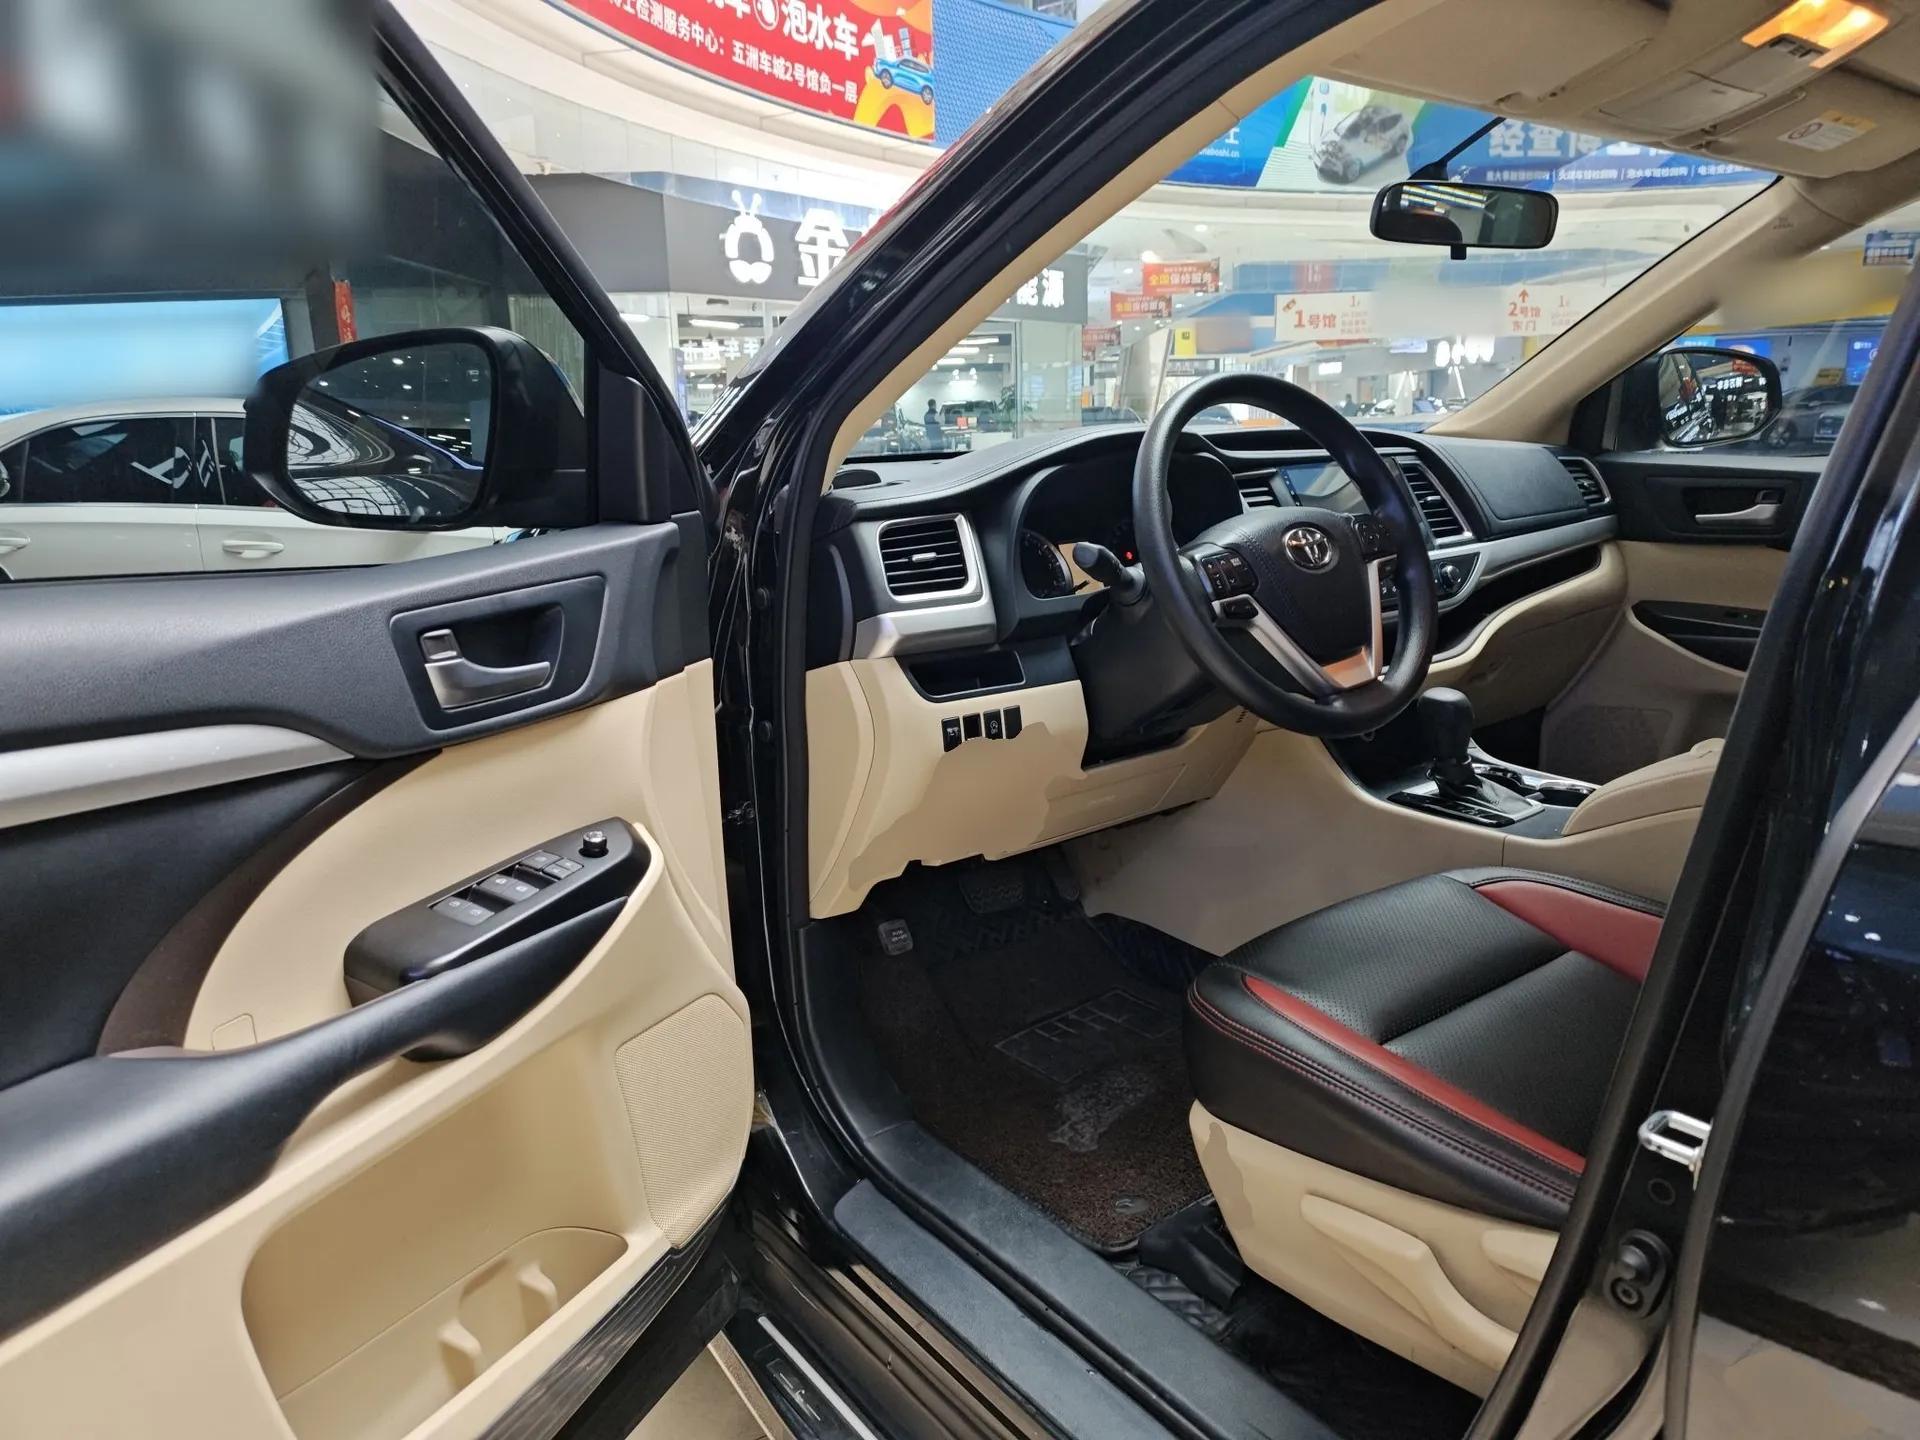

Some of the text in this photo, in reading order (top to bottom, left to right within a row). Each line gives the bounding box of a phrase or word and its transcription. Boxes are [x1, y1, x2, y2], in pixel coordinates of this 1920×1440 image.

[781, 0, 859, 61] 泡水车
[795, 208, 848, 287] 金
[1006, 268, 1064, 308] 能源
[1294, 309, 1337, 330] 1号馆
[1508, 302, 1541, 318] 2号馆
